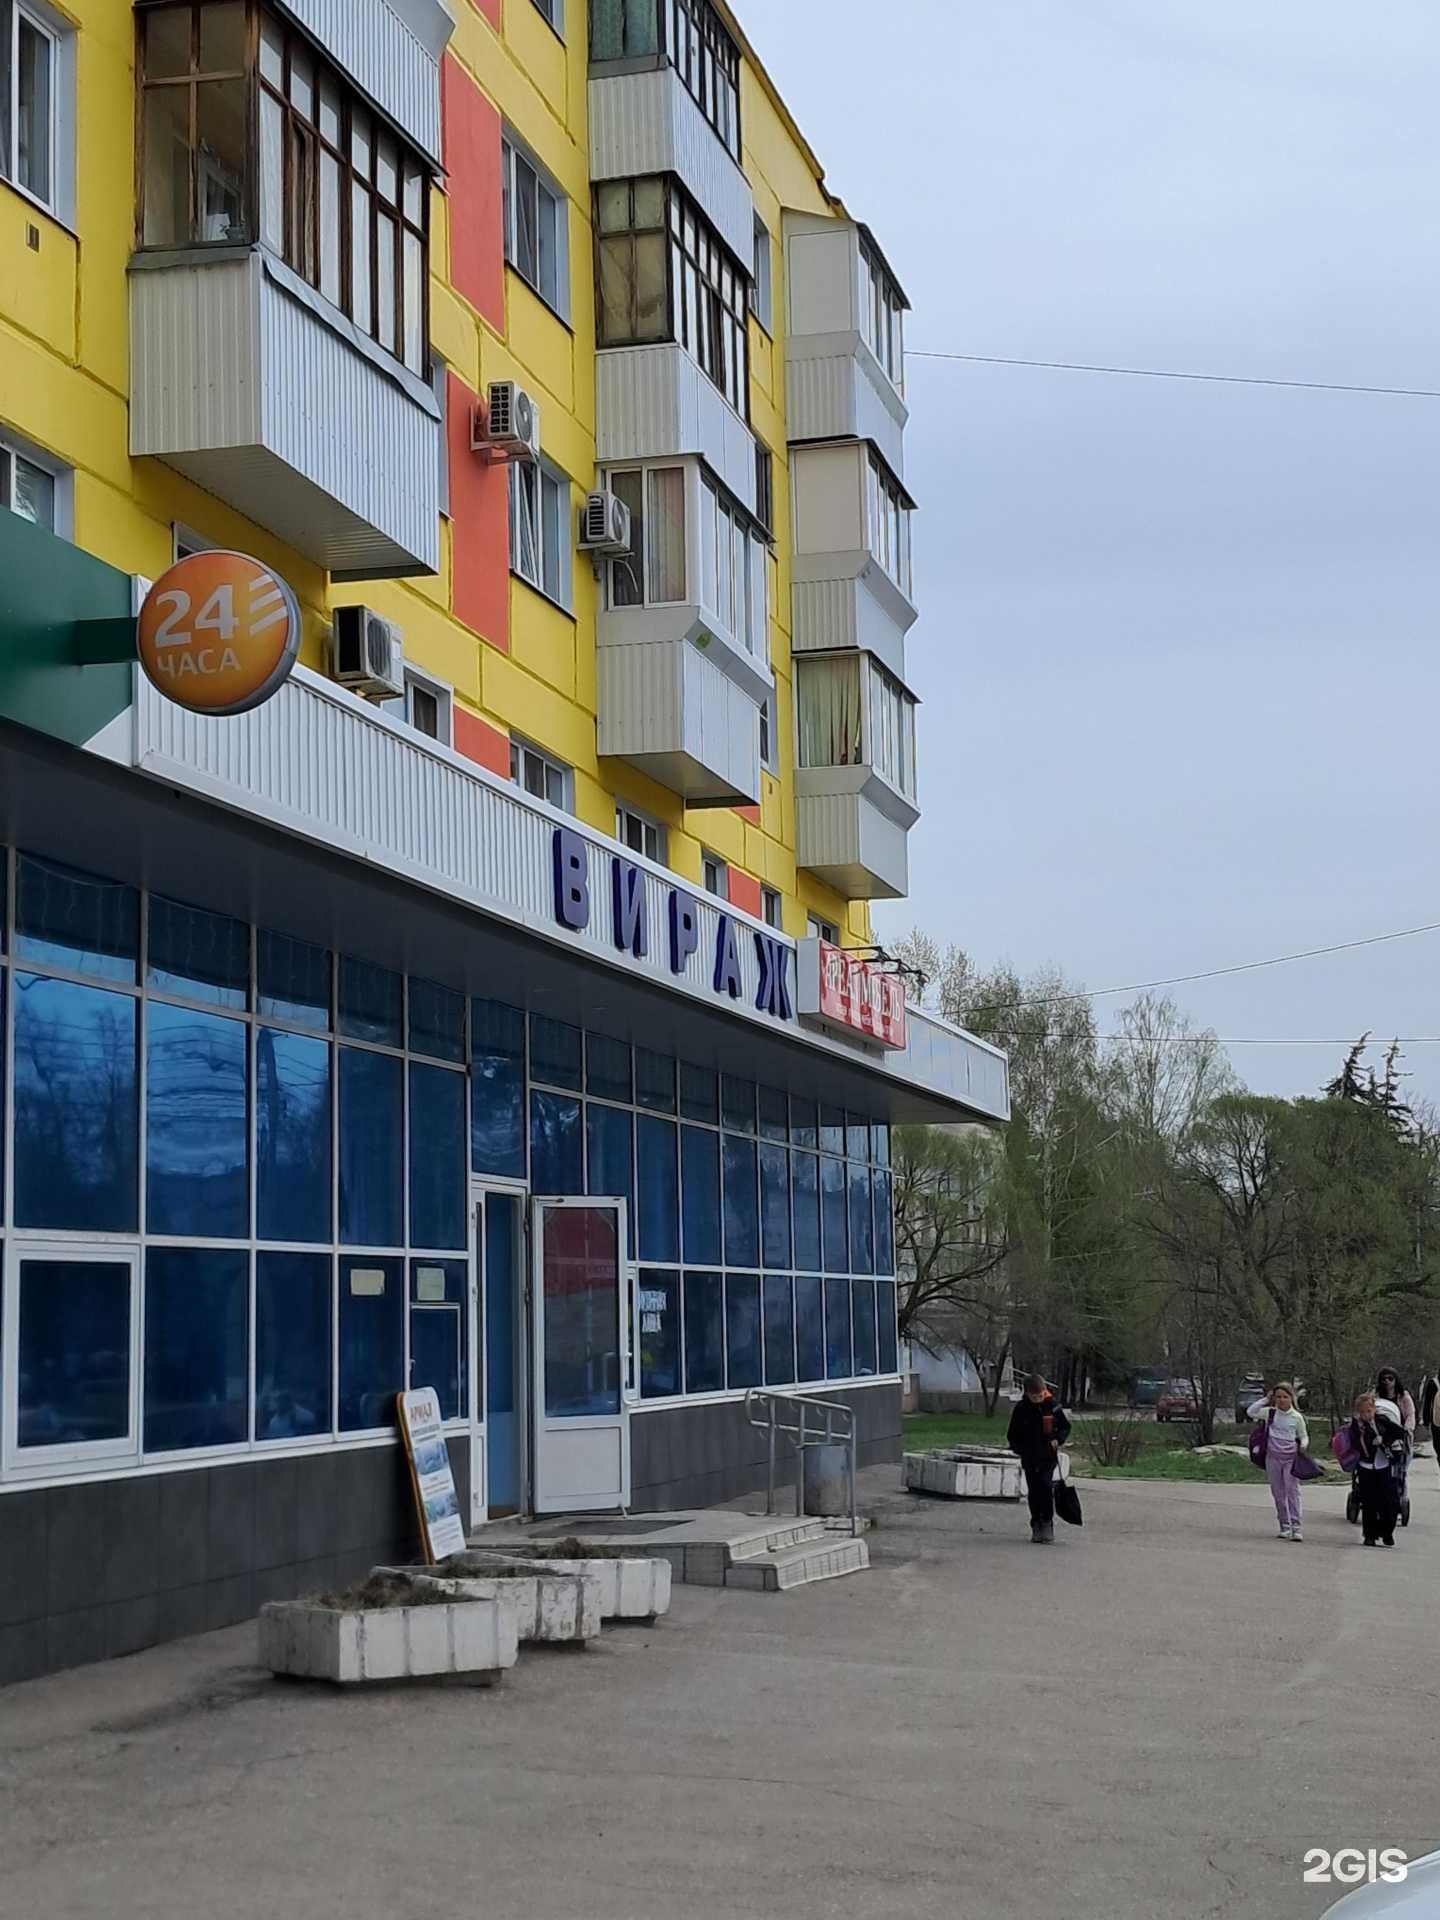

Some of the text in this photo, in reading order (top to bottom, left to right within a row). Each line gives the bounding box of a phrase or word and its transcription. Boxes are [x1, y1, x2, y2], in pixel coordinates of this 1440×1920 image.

[154, 584, 240, 648] 24
[156, 647, 241, 678] ЧАСА
[552, 828, 792, 1020] ВИРАЖ
